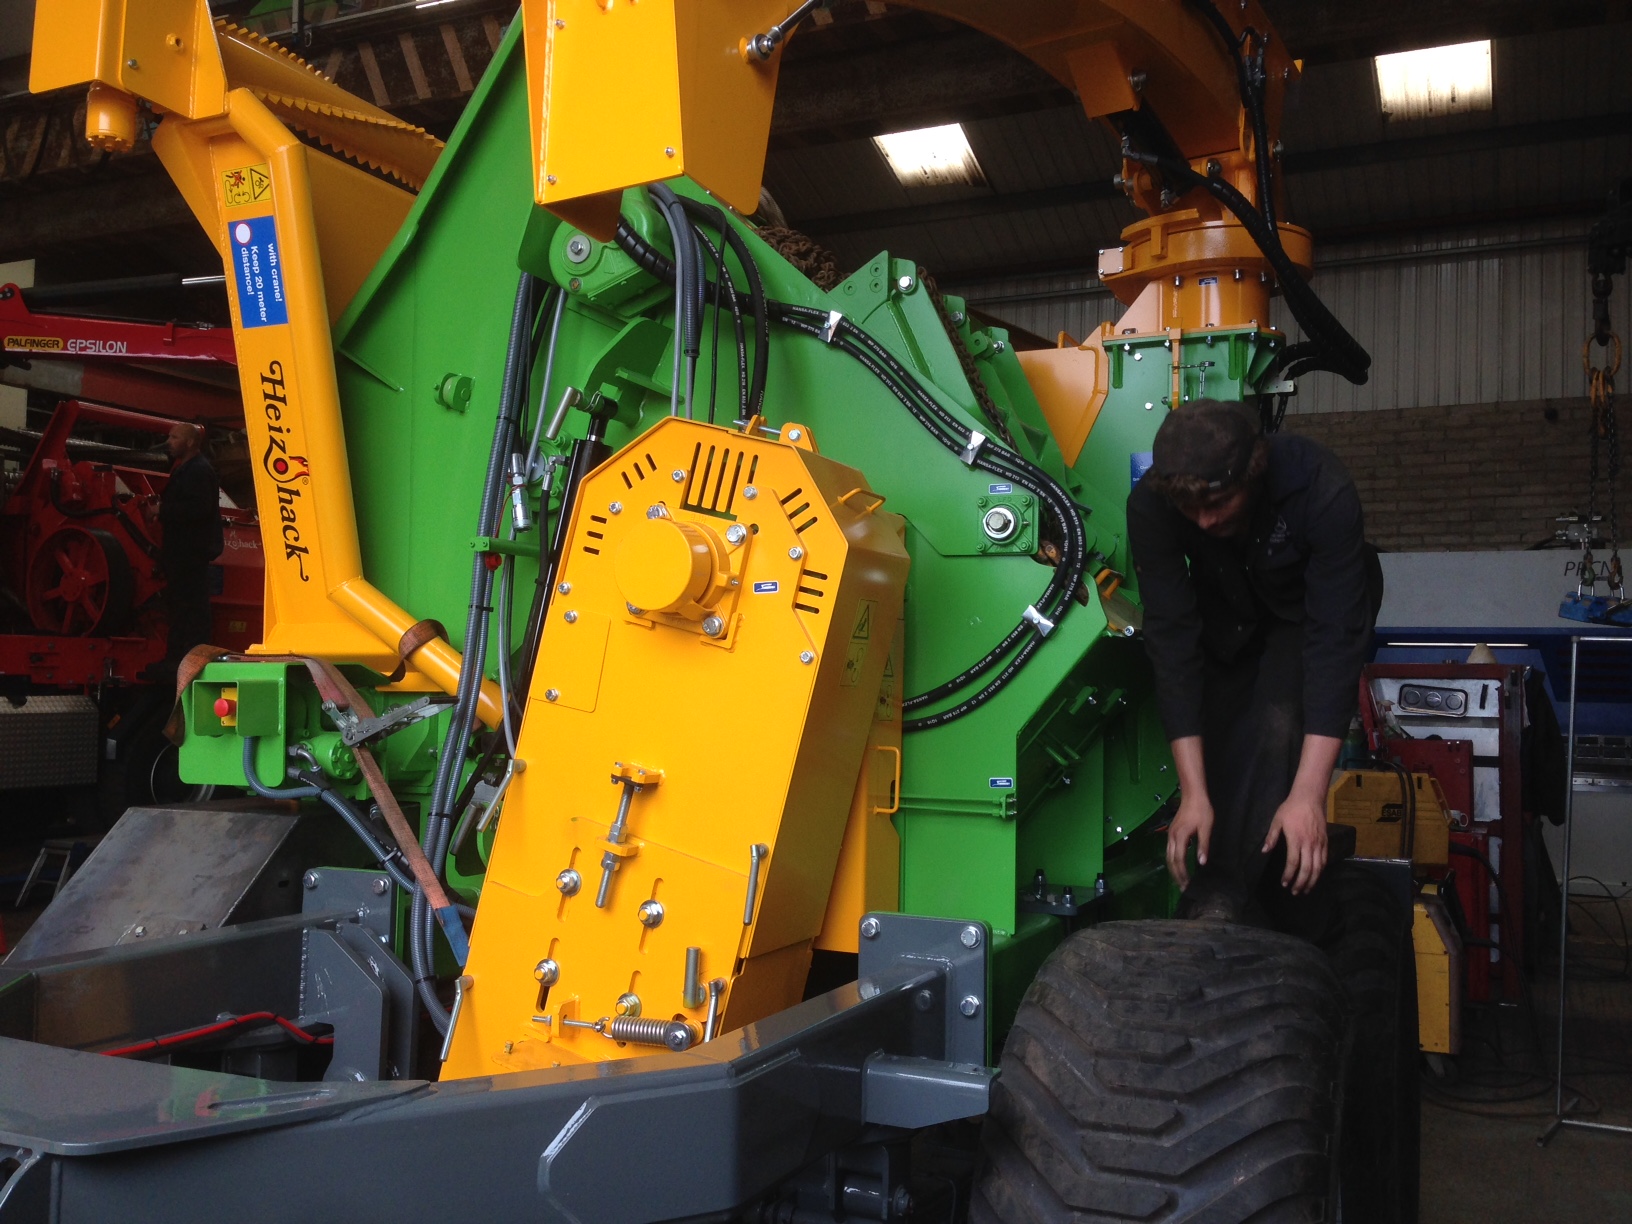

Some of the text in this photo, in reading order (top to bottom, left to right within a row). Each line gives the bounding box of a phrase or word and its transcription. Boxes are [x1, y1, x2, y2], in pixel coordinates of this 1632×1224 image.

[241, 247, 255, 295] distance!
[268, 243, 283, 302] with crane!
[250, 245, 267, 322] Keep 20 meter
[793, 307, 819, 315] HANSA-FLEX
[7, 338, 127, 353] PALFINGER EPSILON
[878, 349, 887, 358] BAR
[859, 354, 880, 375] HANSA-FLEX
[930, 426, 939, 435] BAR
[916, 390, 938, 411] HANSA-FLEX
[1001, 450, 1011, 458] BAR
[977, 459, 1003, 474] HANSA-FLEX
[1049, 482, 1071, 507] HANSA-FLEX
[1064, 590, 1072, 601] BAR
[1036, 583, 1055, 609] HANSA-FLEX
[1014, 641, 1036, 666] HANSA-FLEX
[969, 665, 979, 674] BAR
[942, 712, 952, 720] BAR
